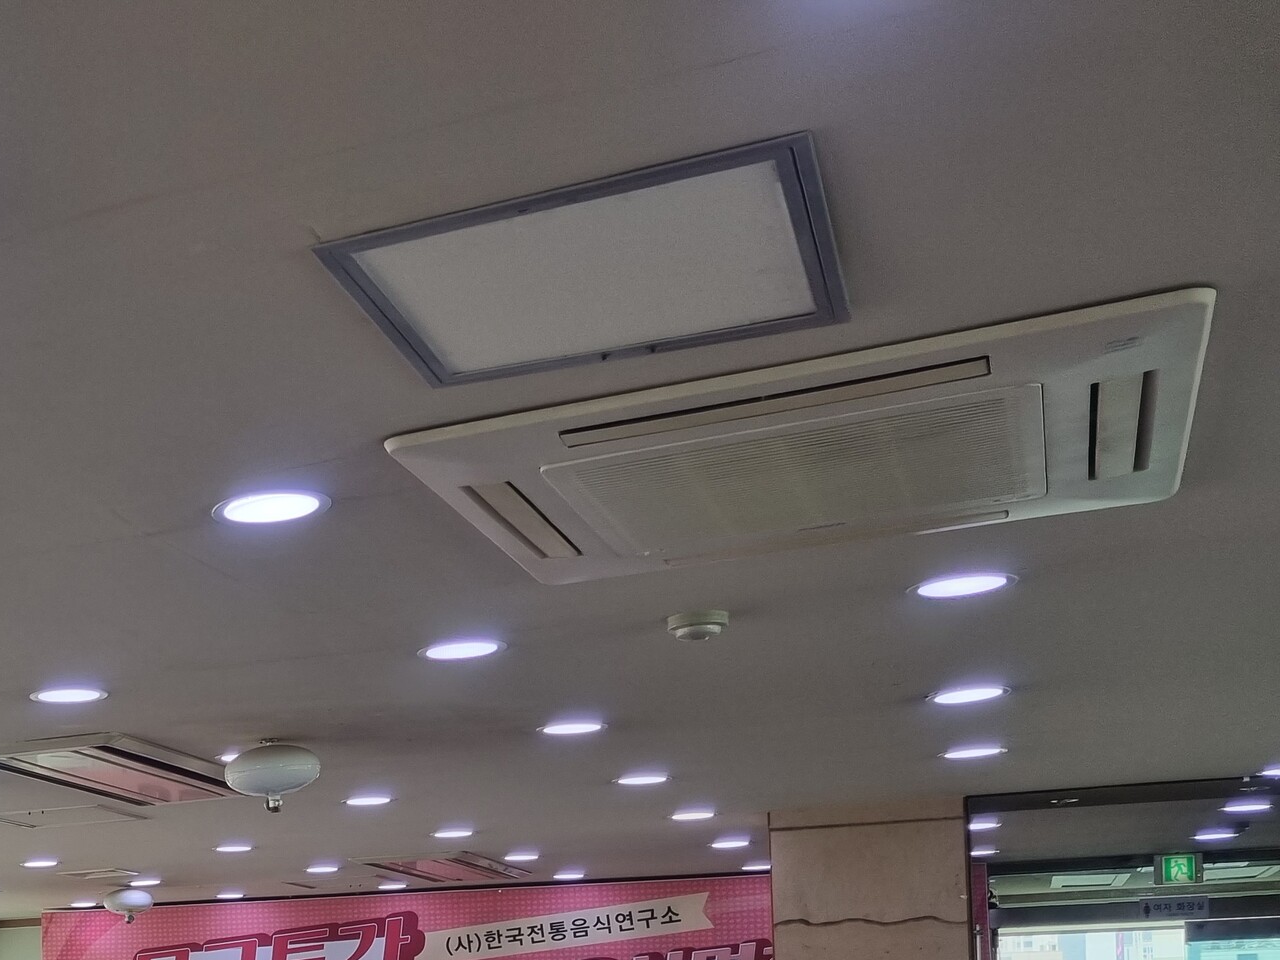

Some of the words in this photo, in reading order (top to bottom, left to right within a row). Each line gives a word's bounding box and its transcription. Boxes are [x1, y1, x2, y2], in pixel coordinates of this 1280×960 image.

[1152, 904, 1172, 912] 여자
[1176, 901, 1205, 911] 화장실
[445, 905, 683, 956] (사)한국전통음식연구소
